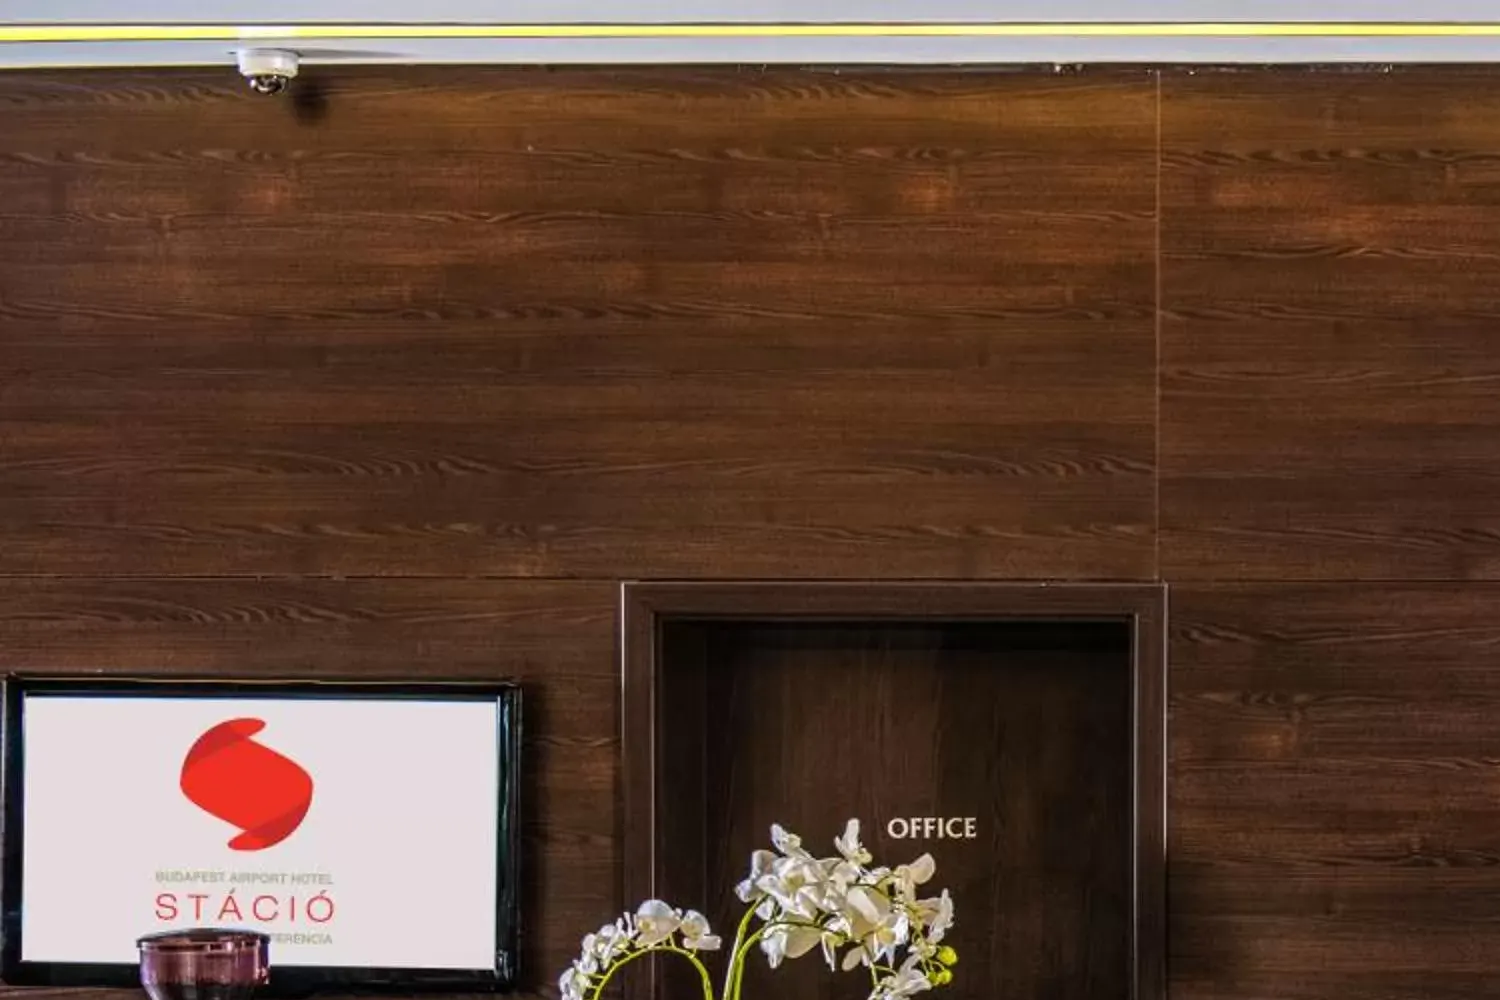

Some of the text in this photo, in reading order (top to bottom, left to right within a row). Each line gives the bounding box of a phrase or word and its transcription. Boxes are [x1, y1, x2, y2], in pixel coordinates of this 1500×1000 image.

[887, 817, 977, 839] OFFICE
[229, 872, 287, 884] AIRPORT
[290, 873, 334, 885] HOTEL
[155, 888, 335, 923] STÁCIÓ
